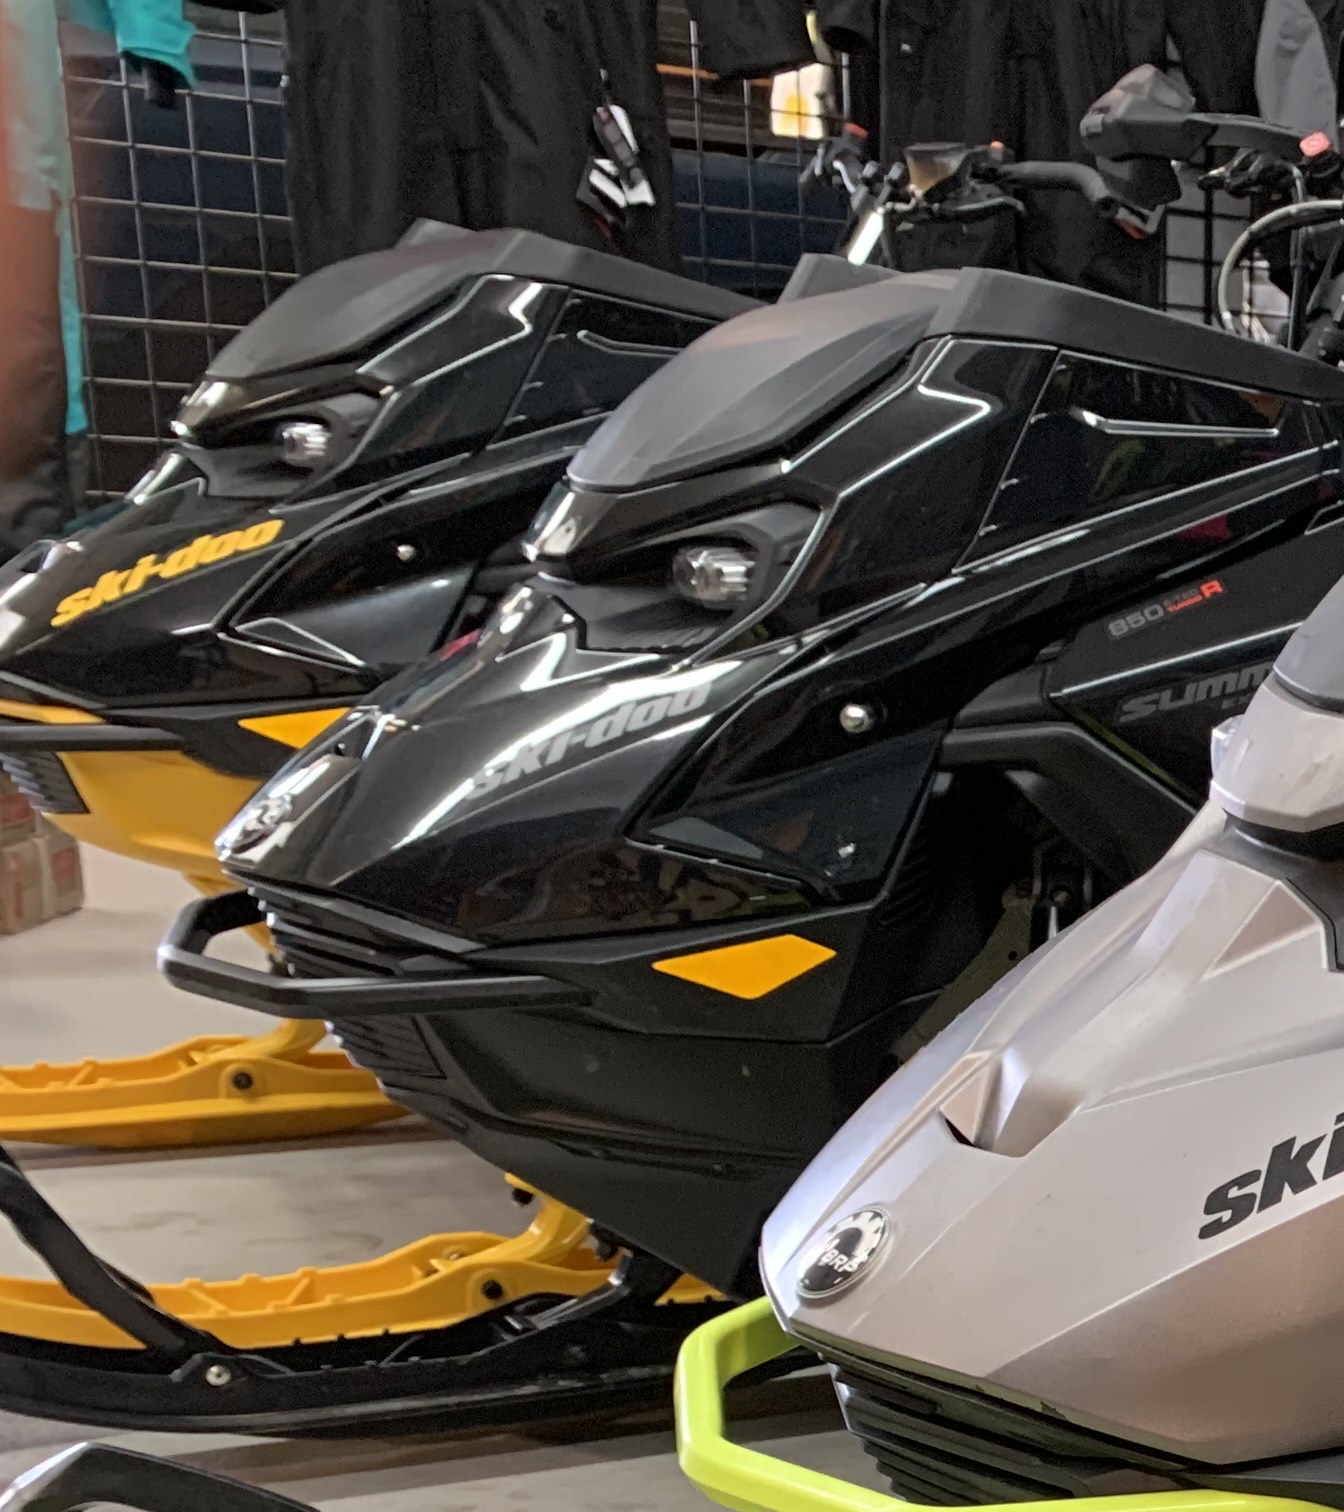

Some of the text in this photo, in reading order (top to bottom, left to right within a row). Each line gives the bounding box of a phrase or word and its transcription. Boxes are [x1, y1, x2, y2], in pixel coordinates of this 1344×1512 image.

[50, 519, 286, 628] ski-doo
[1118, 660, 1274, 723] SUMM
[464, 680, 713, 801] ski-doo
[819, 1248, 859, 1273] BRP
